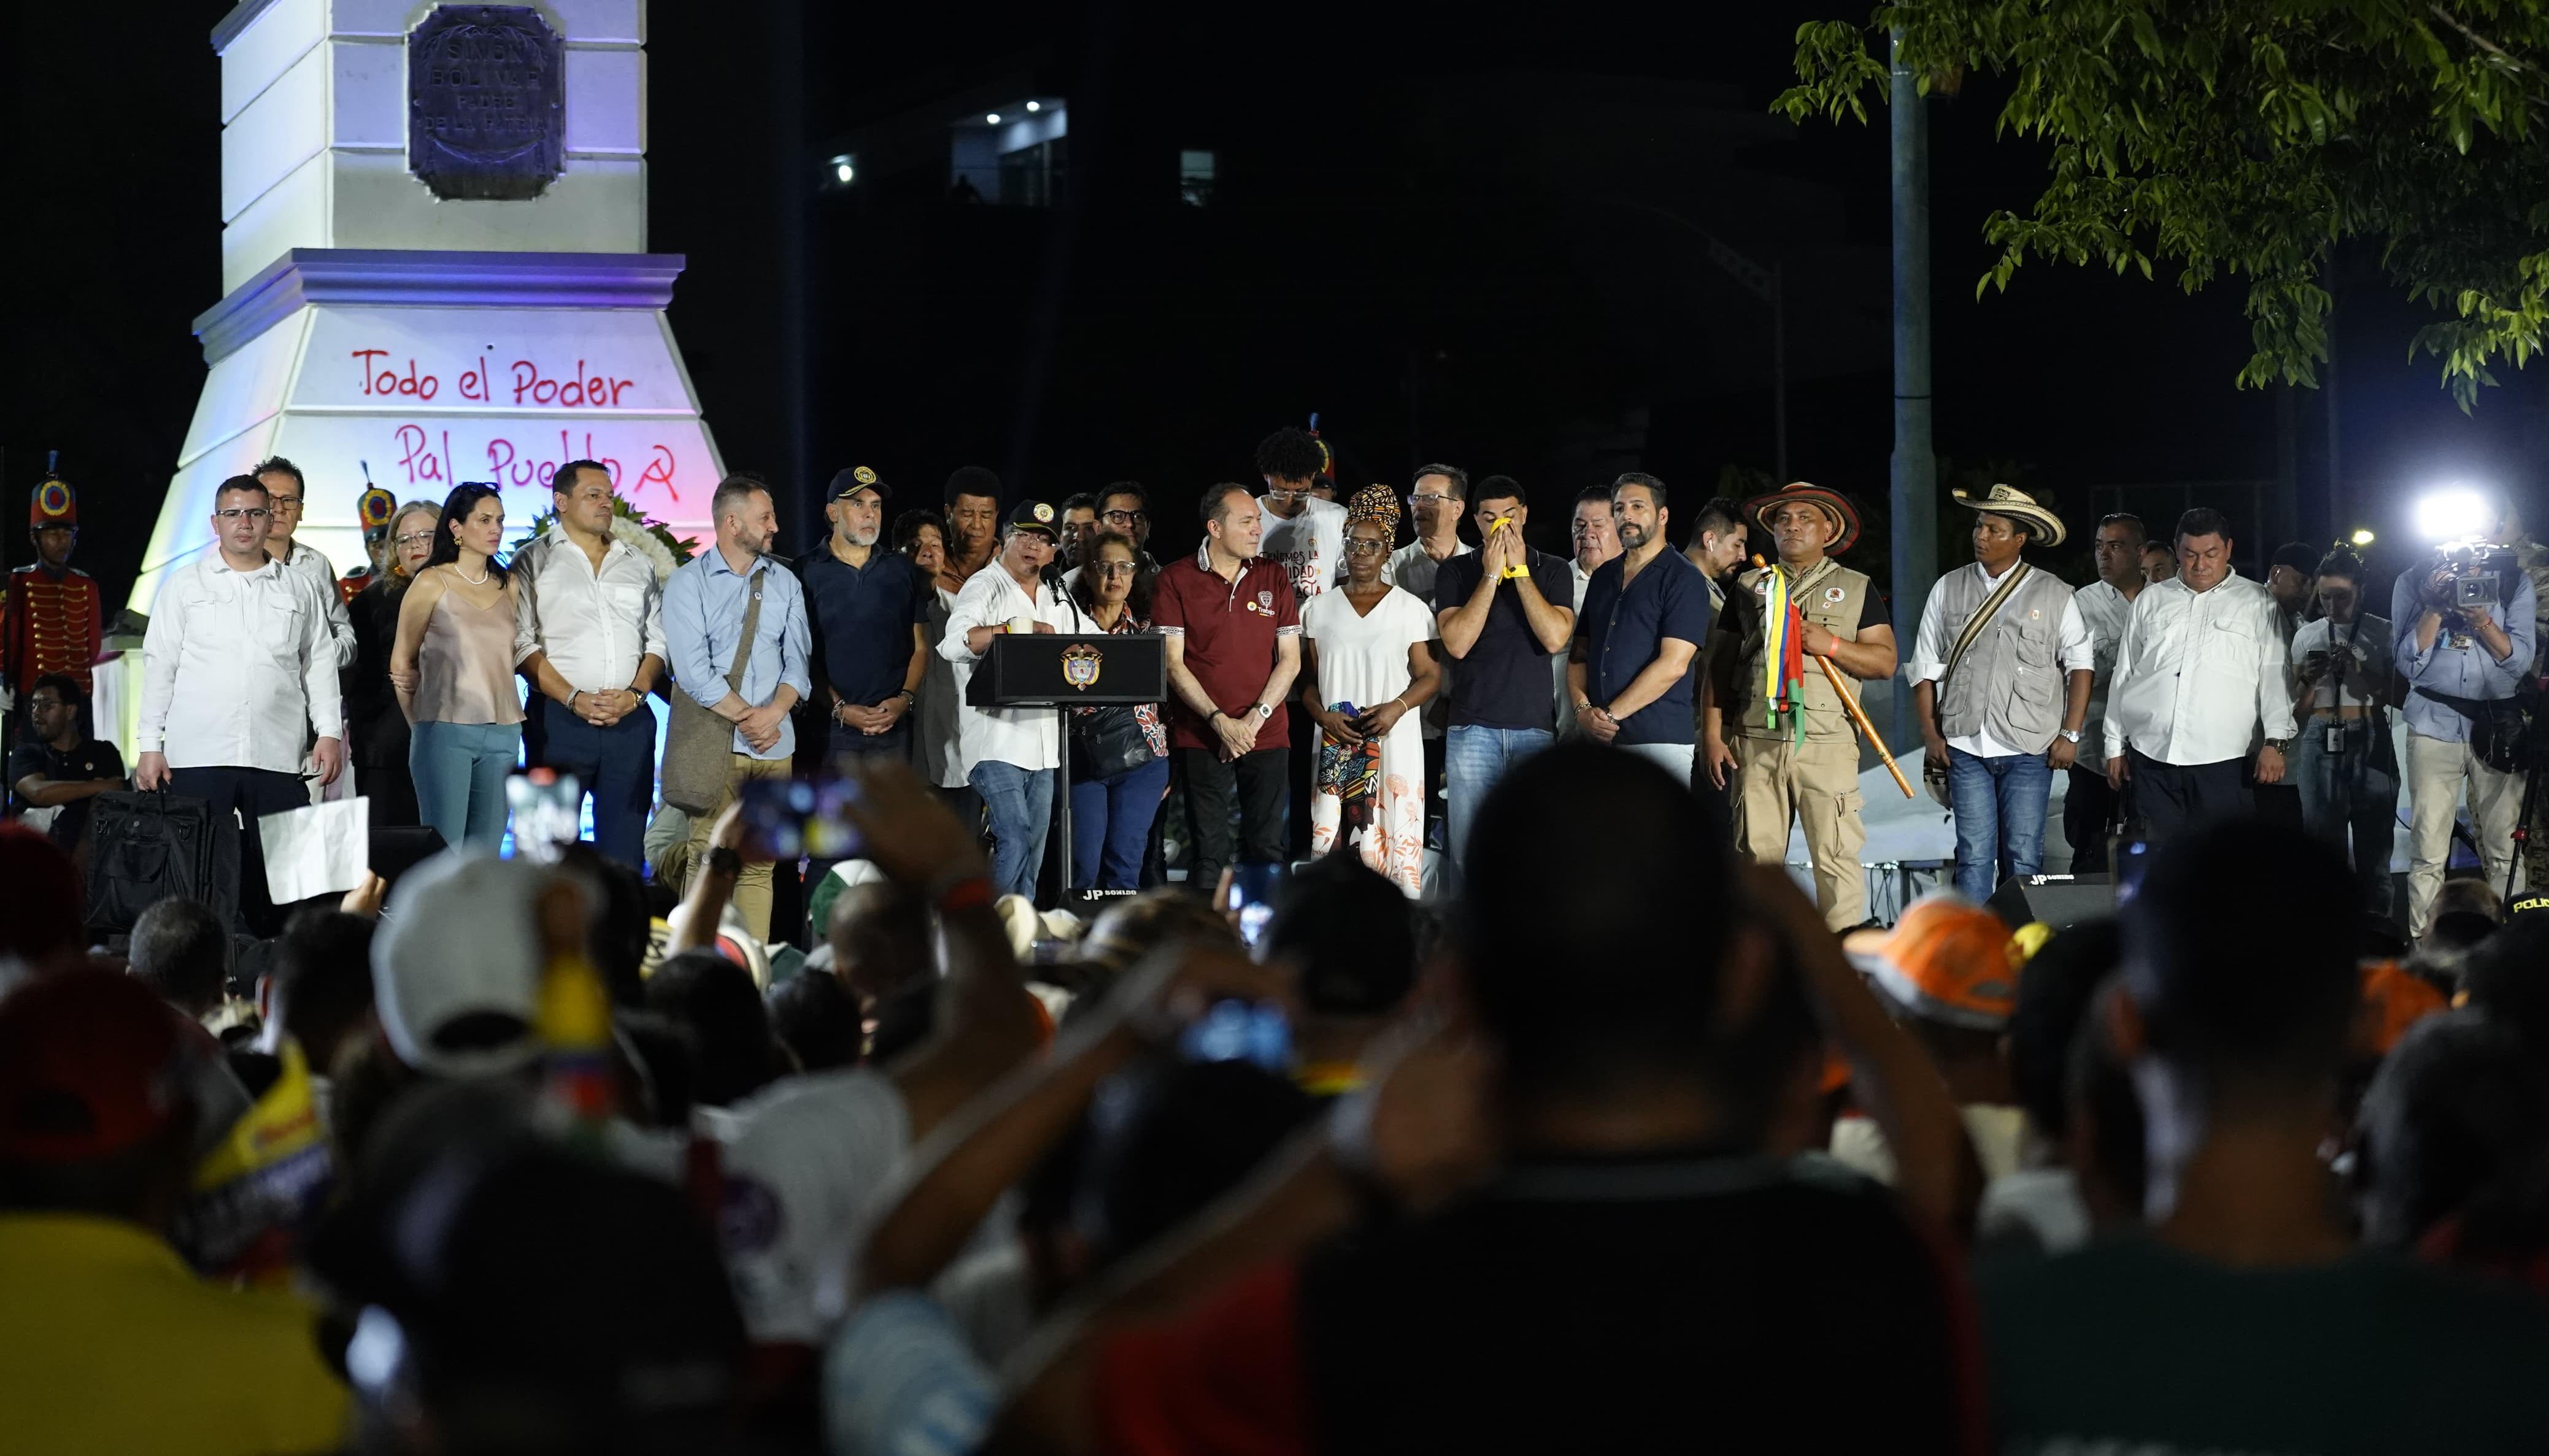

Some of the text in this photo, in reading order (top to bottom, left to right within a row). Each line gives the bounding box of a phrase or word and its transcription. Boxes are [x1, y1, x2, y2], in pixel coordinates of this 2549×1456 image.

[352, 349, 634, 407] Todo el Poder
[395, 424, 453, 487] Pal
[1259, 550, 1319, 566] TENEMOS LA
[2030, 874, 2047, 885] JP
[1082, 890, 1103, 900] JP
